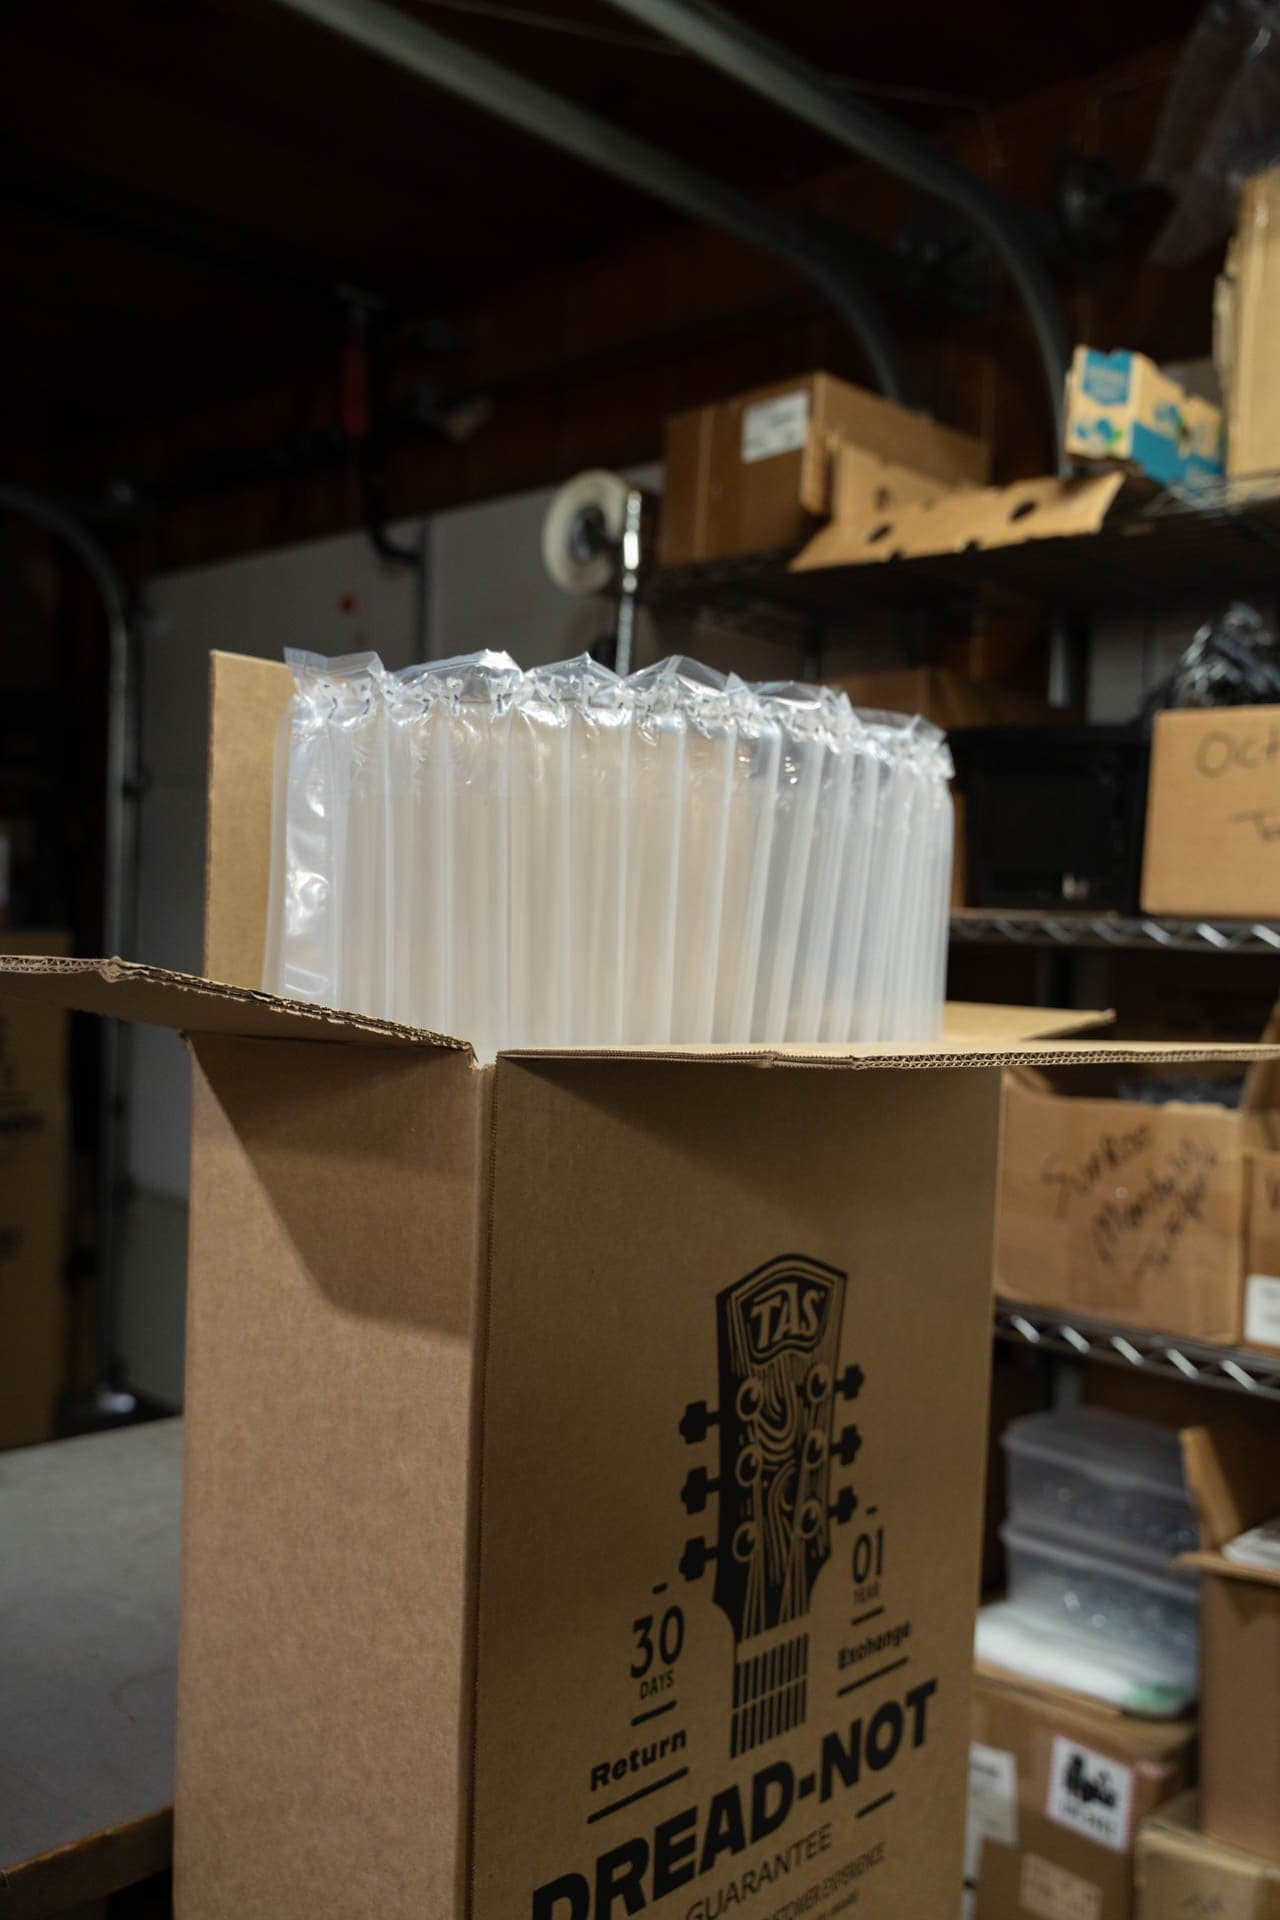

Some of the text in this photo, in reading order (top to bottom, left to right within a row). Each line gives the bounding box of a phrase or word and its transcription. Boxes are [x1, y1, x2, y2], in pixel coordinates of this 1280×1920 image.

[750, 1282, 825, 1350] TAS
[631, 1606, 684, 1678] 30
[640, 1669, 674, 1699] DAYS
[591, 1730, 687, 1791] Return
[533, 1678, 937, 1920] DREAD-NOT
[686, 1822, 833, 1920] GUARANTEE
